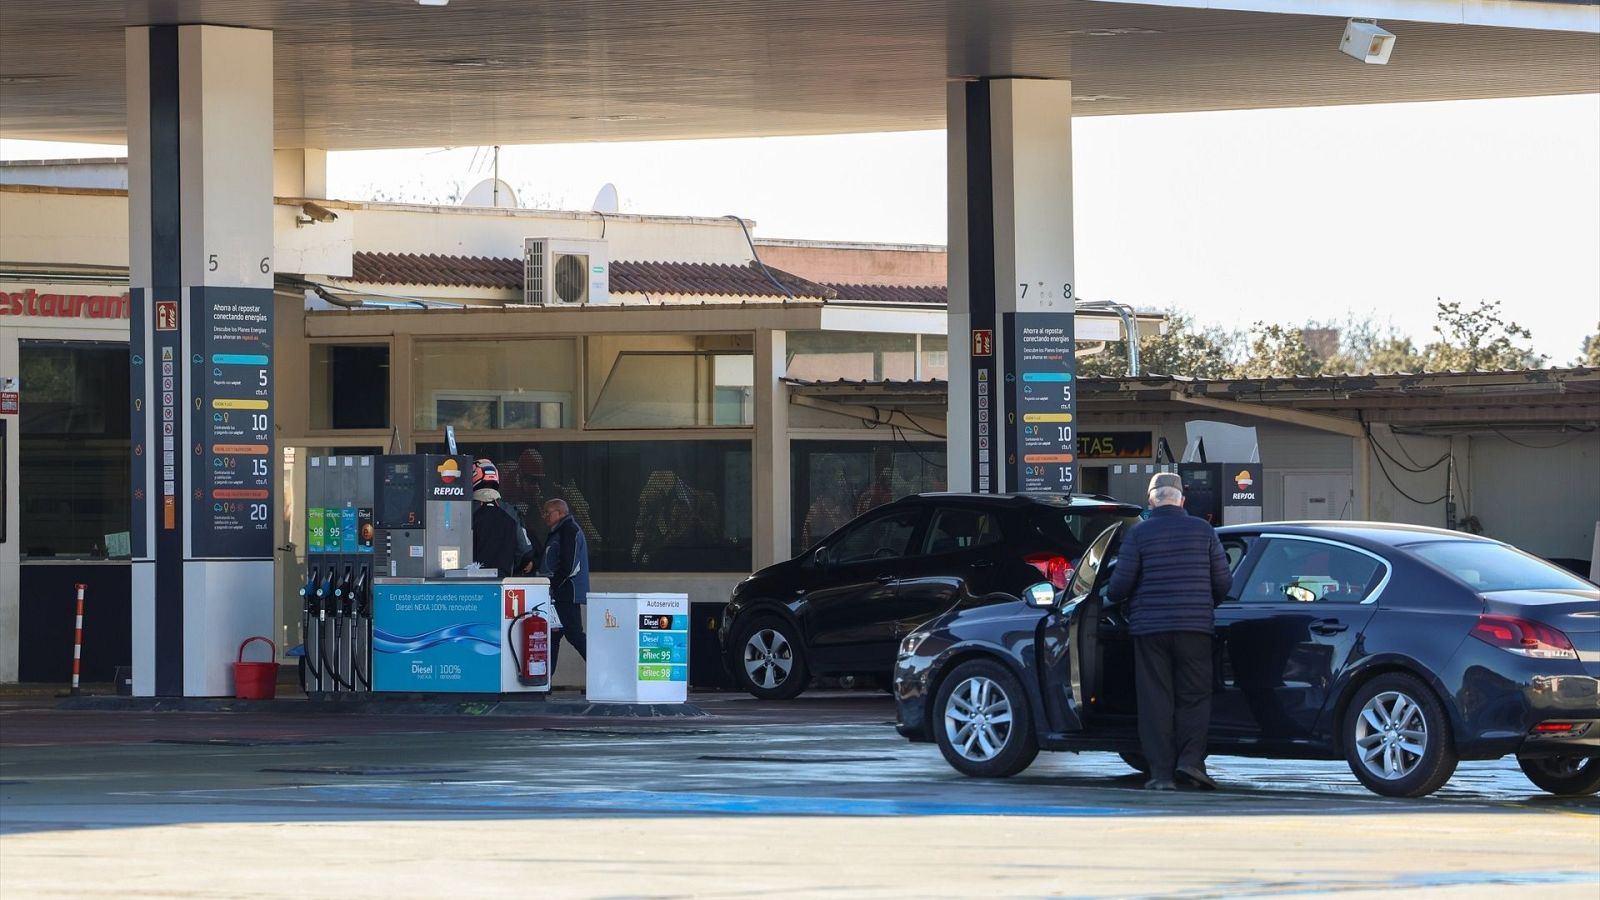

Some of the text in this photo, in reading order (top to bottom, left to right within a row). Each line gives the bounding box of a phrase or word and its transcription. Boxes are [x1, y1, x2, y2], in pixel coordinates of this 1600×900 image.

[209, 254, 218, 272] 5
[260, 256, 270, 274] 6
[1020, 283, 1028, 298] 7
[1063, 283, 1072, 299] 8
[238, 305, 260, 313] repostar
[260, 369, 268, 386] 5
[1064, 386, 1071, 401] 5
[252, 414, 267, 431] 10
[1058, 426, 1071, 441] 10
[1077, 437, 1113, 454] TAS
[252, 459, 267, 475] 15
[1060, 467, 1072, 482] 15
[434, 487, 464, 495] REPSOL
[250, 504, 267, 520] 20
[314, 528, 323, 537] 98
[330, 528, 340, 537] 95
[436, 594, 457, 602] puedes
[643, 650, 671, 660] efitec 95
[412, 664, 433, 674] Diesel
[440, 664, 461, 674] 100%
[661, 669, 671, 678] 98
